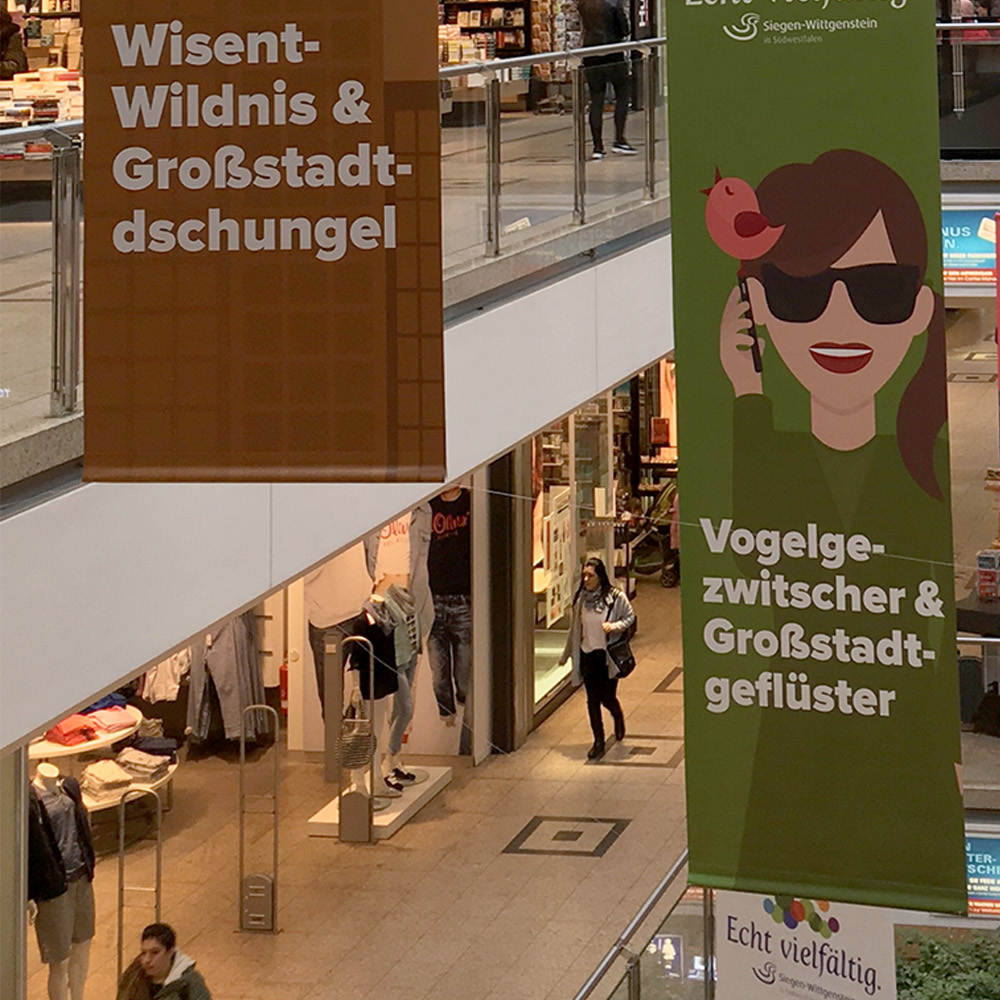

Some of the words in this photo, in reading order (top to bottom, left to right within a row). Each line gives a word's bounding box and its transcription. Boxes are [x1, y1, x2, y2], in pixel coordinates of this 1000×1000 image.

[111, 20, 320, 66] Wisent-
[763, 17, 877, 33] Siegen-Wittgenstein
[111, 79, 318, 128] Wildnis
[332, 79, 372, 124] &
[112, 142, 412, 190] Großstadt-
[112, 205, 397, 262] dschungel
[699, 517, 885, 569] Vogelge-
[702, 568, 906, 614] zwitscher
[914, 580, 945, 618] &
[703, 617, 936, 667] Großstadt-
[704, 671, 896, 717] geflüster
[727, 915, 772, 954] Echt
[780, 937, 882, 996] vielfältig.
[779, 973, 856, 1000] Siegen-Wittgenstei
